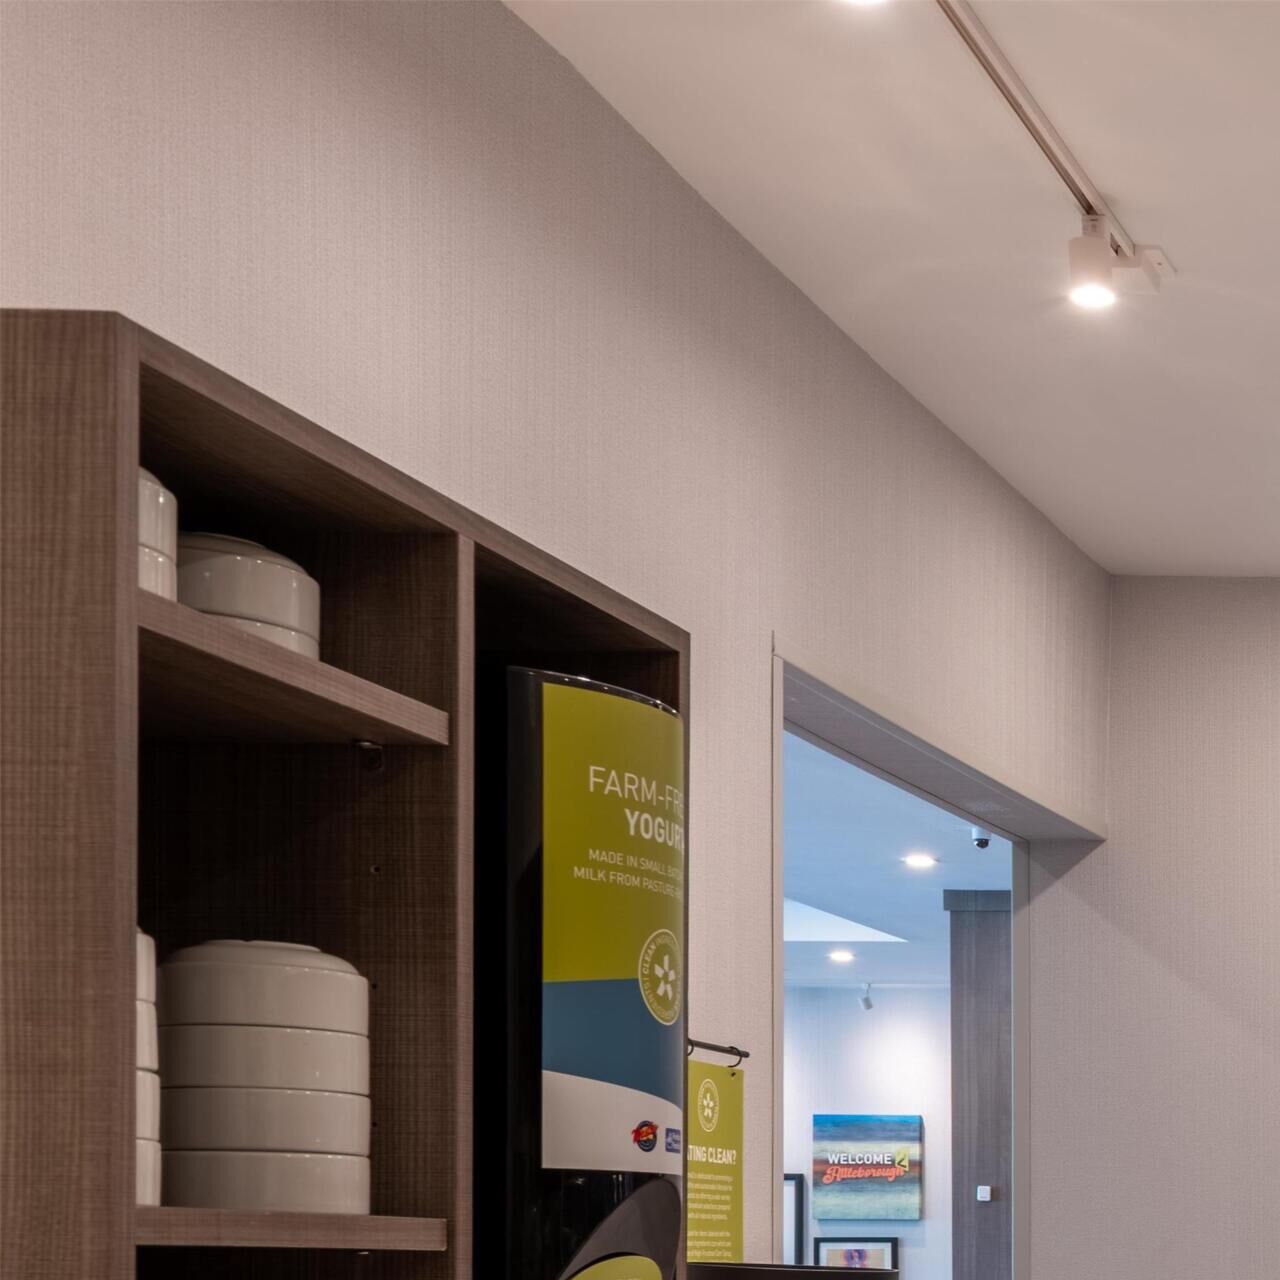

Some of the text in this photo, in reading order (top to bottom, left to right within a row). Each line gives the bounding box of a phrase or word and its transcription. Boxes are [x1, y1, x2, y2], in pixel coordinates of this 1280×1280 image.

[588, 848, 623, 866] MADE
[626, 855, 638, 867] IN
[639, 857, 667, 875] SMALL
[573, 866, 607, 882] MILK
[609, 871, 640, 887] FROM
[707, 1147, 737, 1165] CLEAN?
[827, 1153, 892, 1165] WELCOME
[822, 1165, 905, 1185] Attleborough
